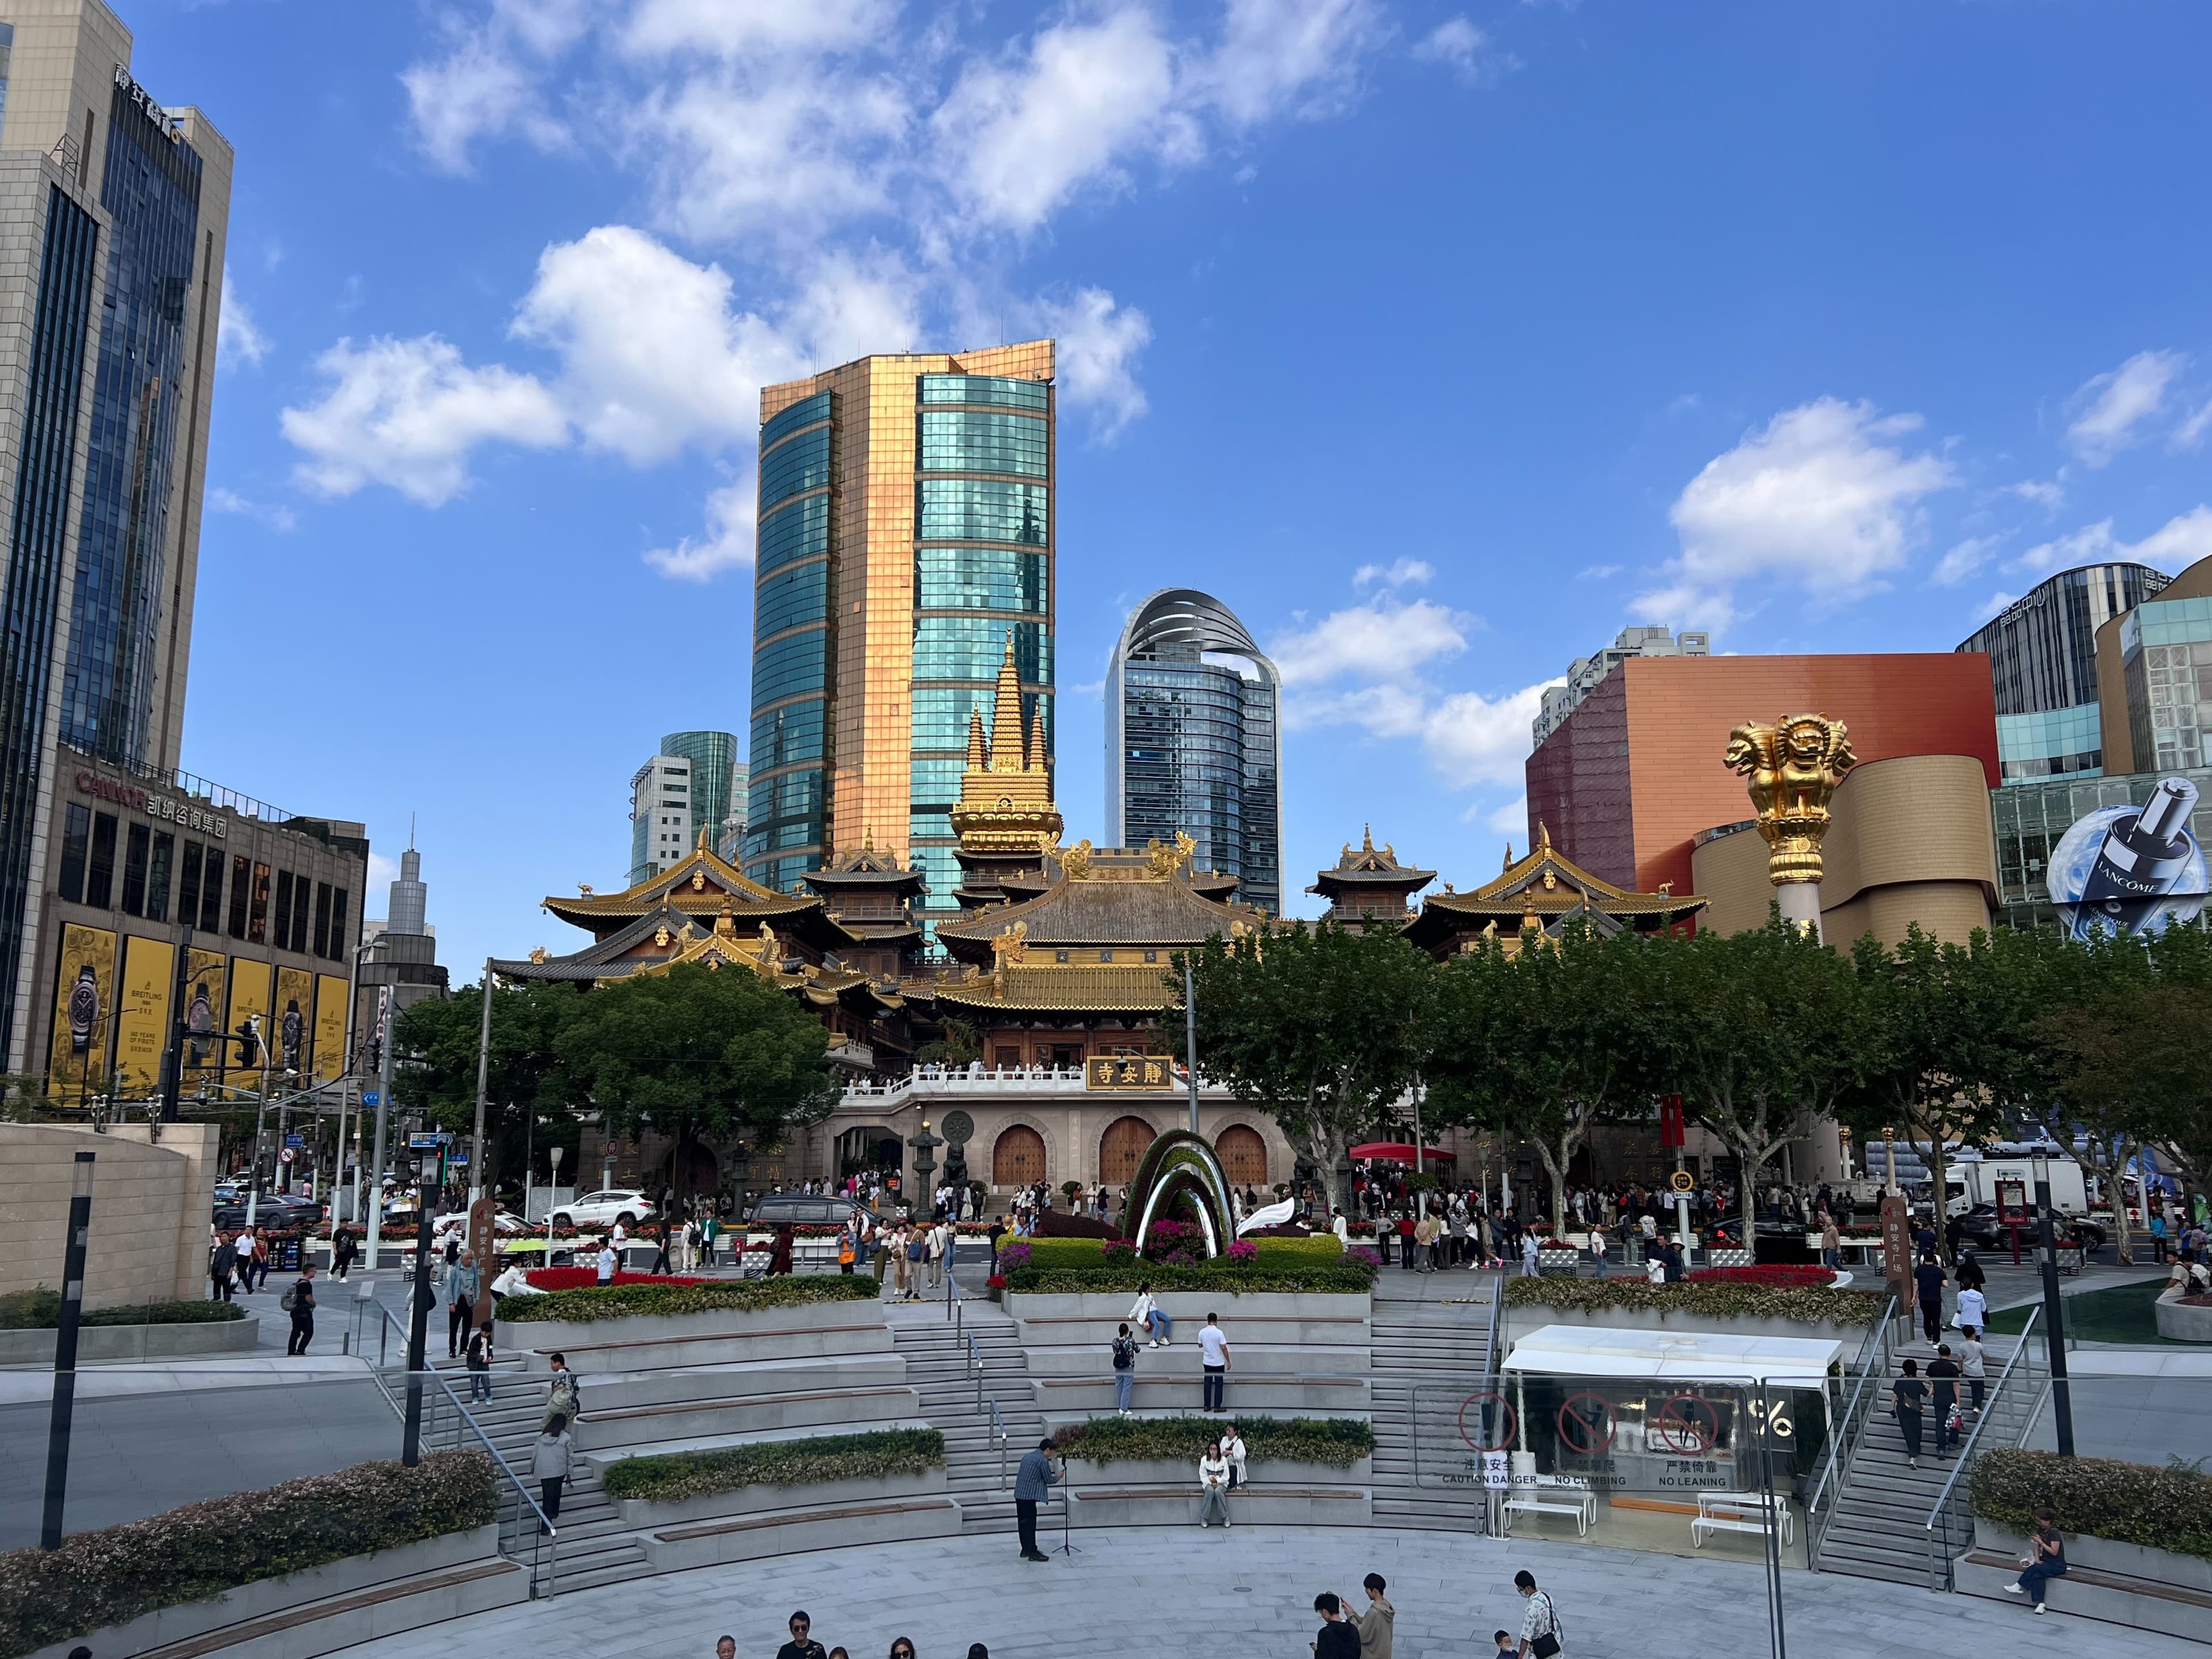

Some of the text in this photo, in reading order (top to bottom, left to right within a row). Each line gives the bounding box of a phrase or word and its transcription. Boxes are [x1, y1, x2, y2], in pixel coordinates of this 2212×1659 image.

[147, 794, 226, 838] 凯纳咨询集团
[2098, 861, 2159, 893] LANCÔME
[131, 990, 162, 1000] BREITLING
[237, 1006, 262, 1014] BREITLING
[478, 1225, 488, 1276] 静安寺广场
[1890, 1223, 1903, 1273] 静安寺广场
[1464, 1459, 1514, 1471] 注意安全
[1666, 1460, 1718, 1473] 严禁倚靠
[1442, 1475, 1537, 1484] CAUTION DANGER
[1555, 1476, 1626, 1485] NO CLIMBING
[1659, 1477, 1726, 1486] NO LEANING
